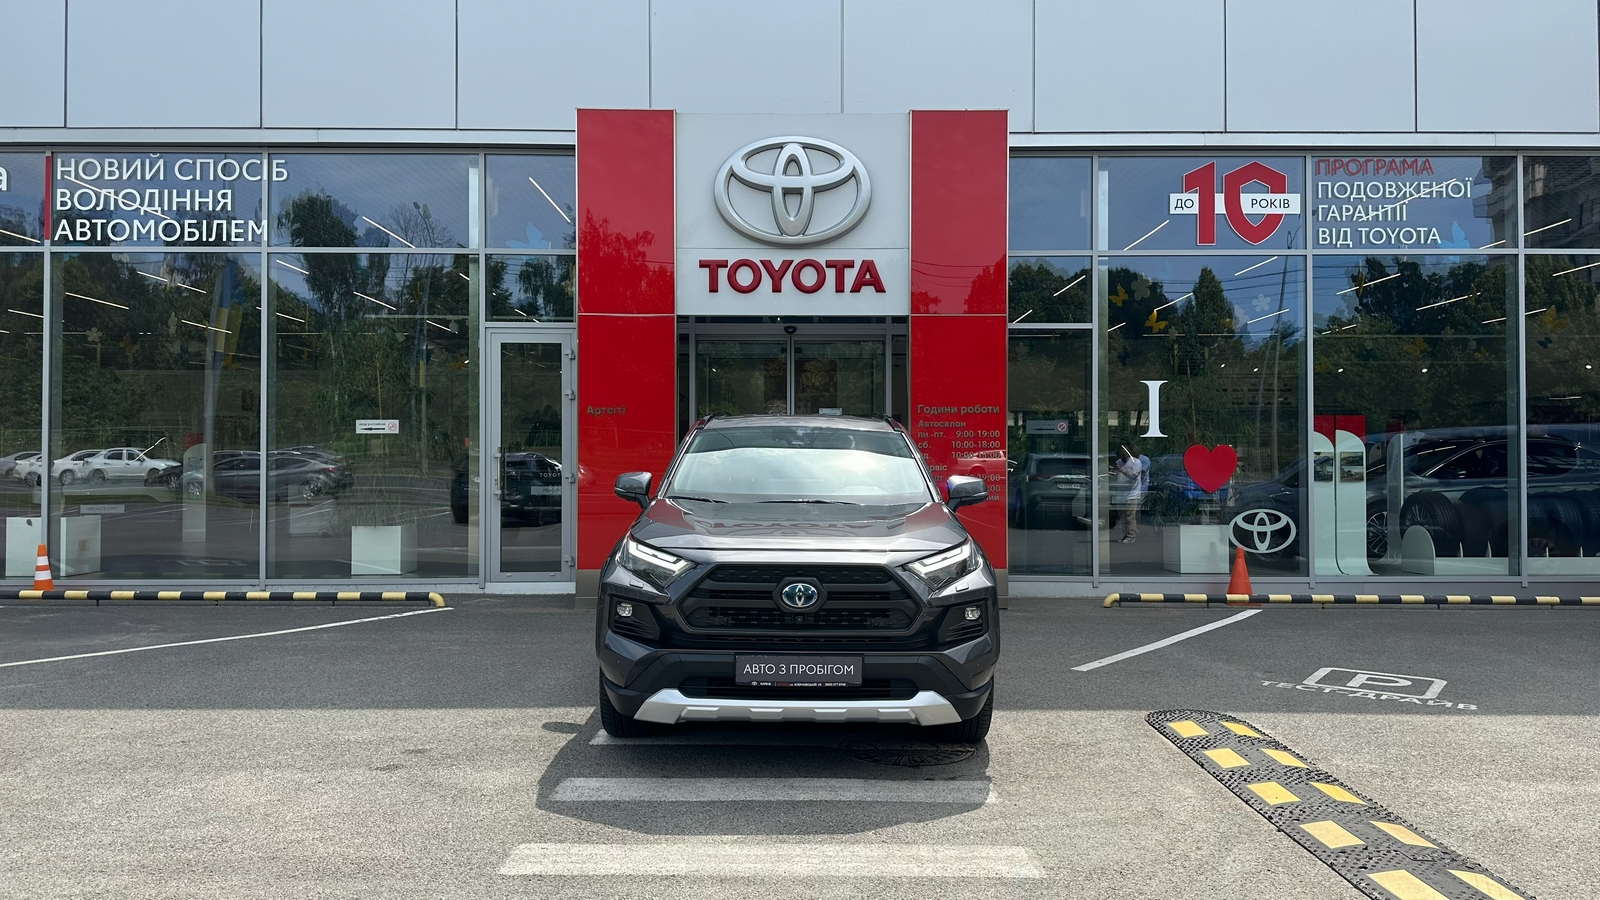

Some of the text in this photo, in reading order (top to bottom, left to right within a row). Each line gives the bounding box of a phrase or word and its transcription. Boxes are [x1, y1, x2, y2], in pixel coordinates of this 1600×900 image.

[57, 153, 288, 181] НОВИЙ СПОСІБ
[1315, 158, 1435, 176] ПРОГРАМА
[1318, 177, 1472, 202] ПОДОВЖЕНОЇ
[56, 188, 232, 215] ВОЛОДІННЯ
[1174, 198, 1194, 211] ДО
[1251, 198, 1290, 209] РОКІВ
[1318, 201, 1408, 221] ГАРАНТІЇ
[54, 219, 268, 242] АВТОМОБІЛЕМ
[1319, 228, 1441, 247] ВІД TOYOTA
[698, 258, 886, 294] TOYOTA
[586, 405, 626, 417] Артсіті
[917, 404, 1000, 416] Години роботи
[955, 430, 1000, 438] 9:00-19:00
[743, 663, 776, 675] АВТО
[789, 664, 854, 675] ПРОБІГОМ
